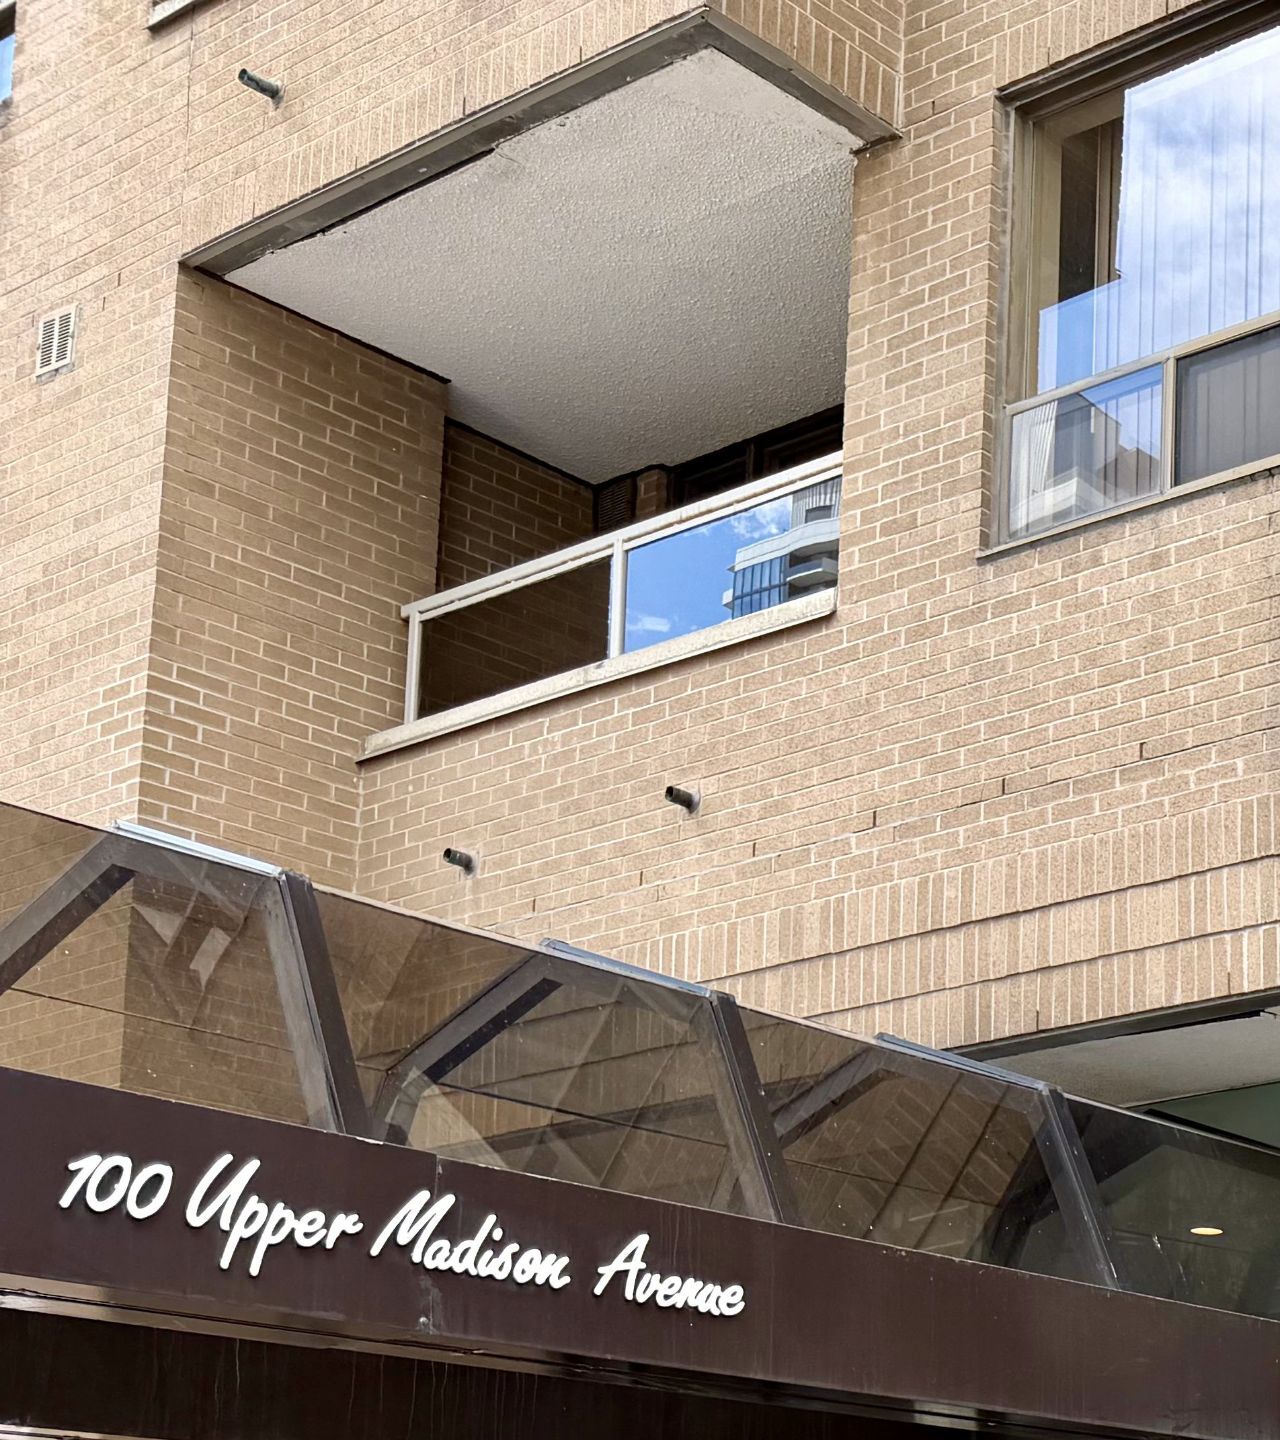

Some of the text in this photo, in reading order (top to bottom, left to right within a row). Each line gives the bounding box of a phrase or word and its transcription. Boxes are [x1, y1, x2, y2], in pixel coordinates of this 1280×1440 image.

[58, 1152, 747, 1317] 100 Upper Madison Avenue
